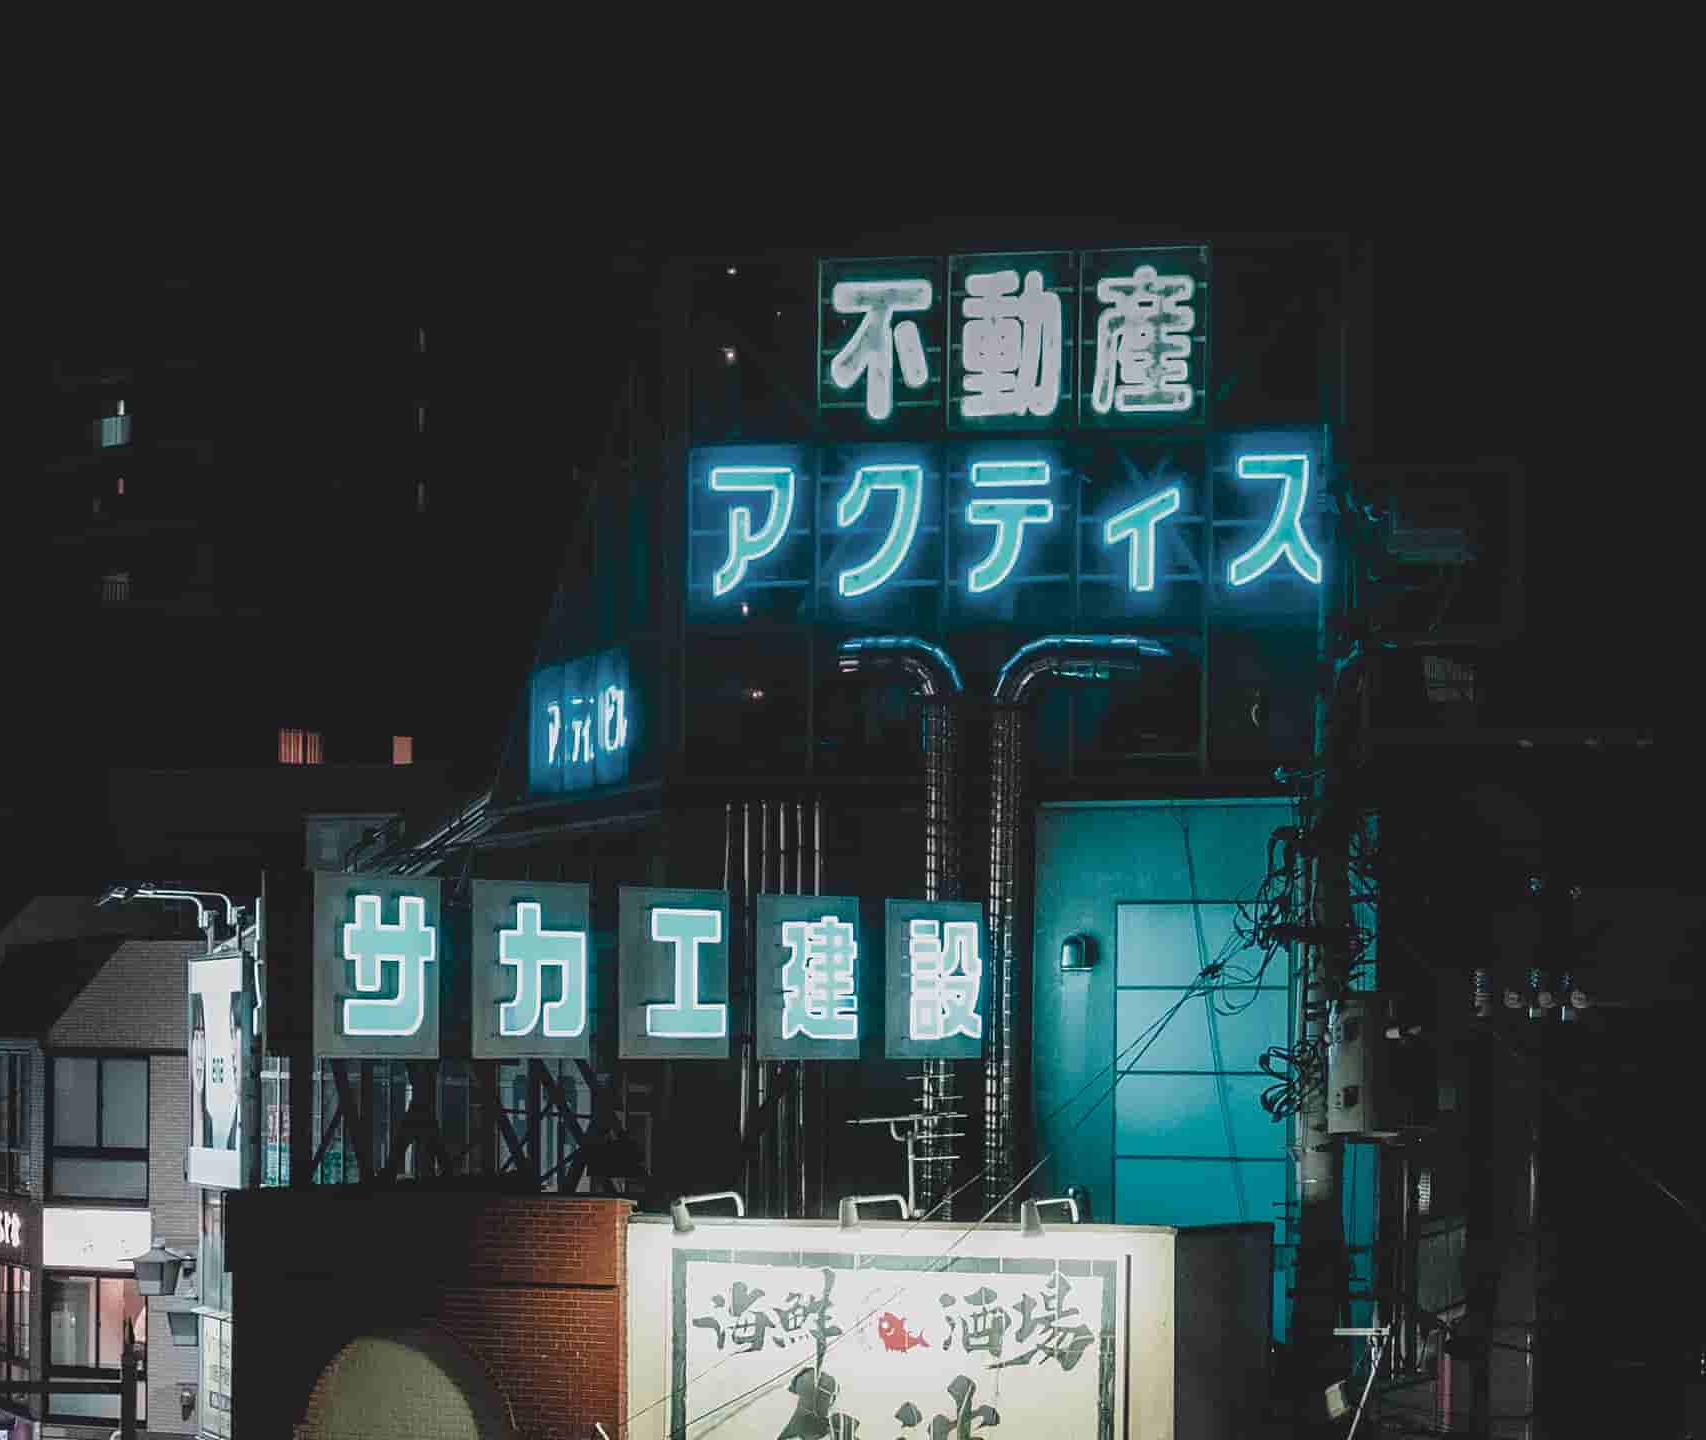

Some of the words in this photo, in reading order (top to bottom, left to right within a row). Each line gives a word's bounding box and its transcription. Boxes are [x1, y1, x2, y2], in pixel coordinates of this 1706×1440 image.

[830, 265, 1195, 421] 不動産
[709, 453, 1324, 599] アクティス
[692, 1267, 842, 1373] 海鮮
[939, 1269, 1096, 1372] 酒場
